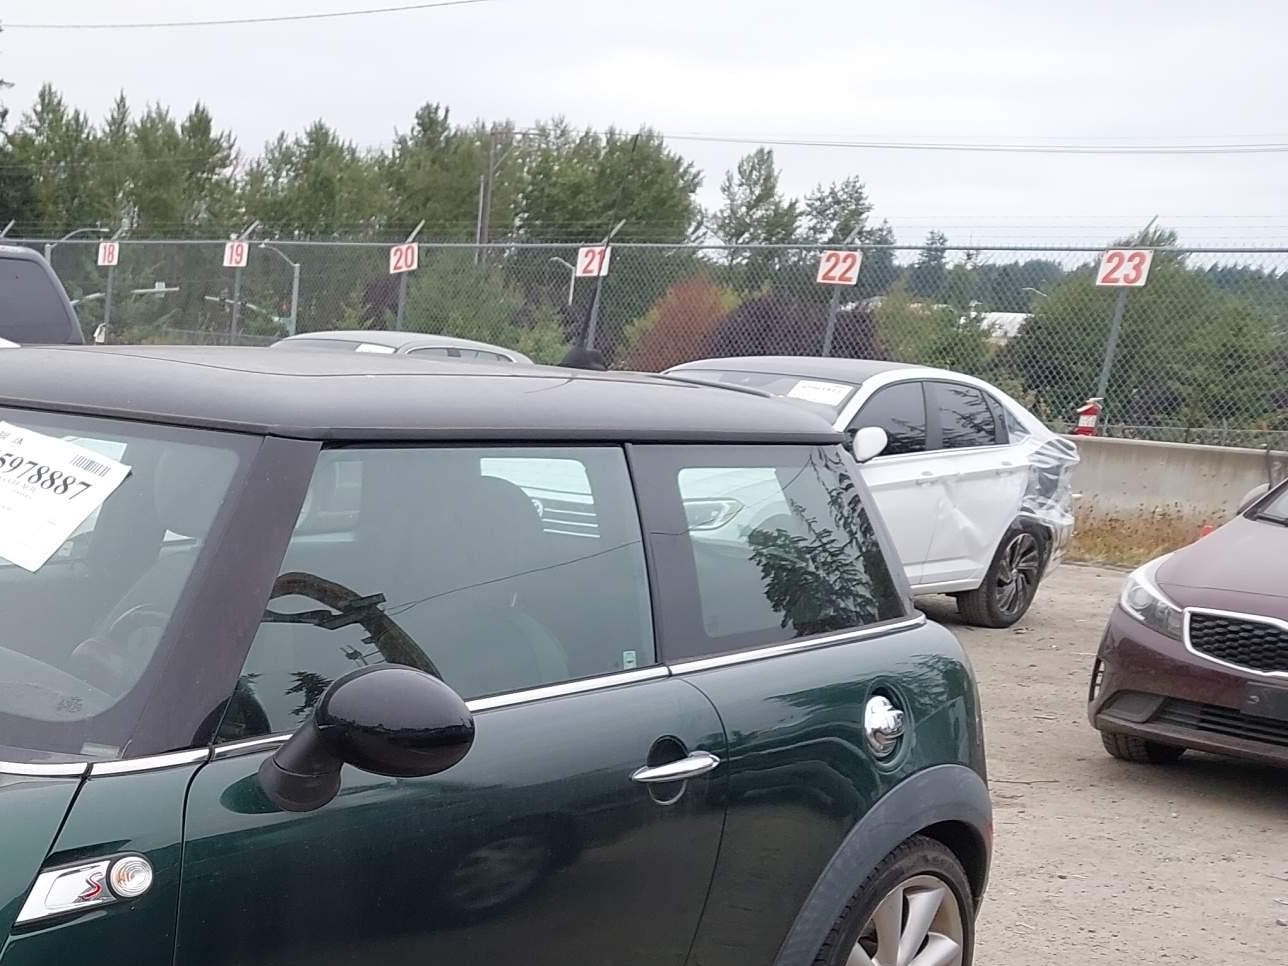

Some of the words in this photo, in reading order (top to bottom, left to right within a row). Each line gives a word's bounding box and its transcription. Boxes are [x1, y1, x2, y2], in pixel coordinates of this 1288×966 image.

[102, 243, 115, 264] 18
[229, 243, 244, 265] 19
[393, 245, 414, 270] 20
[583, 249, 605, 273] 21
[823, 252, 857, 281] 22
[1101, 251, 1146, 284] 23
